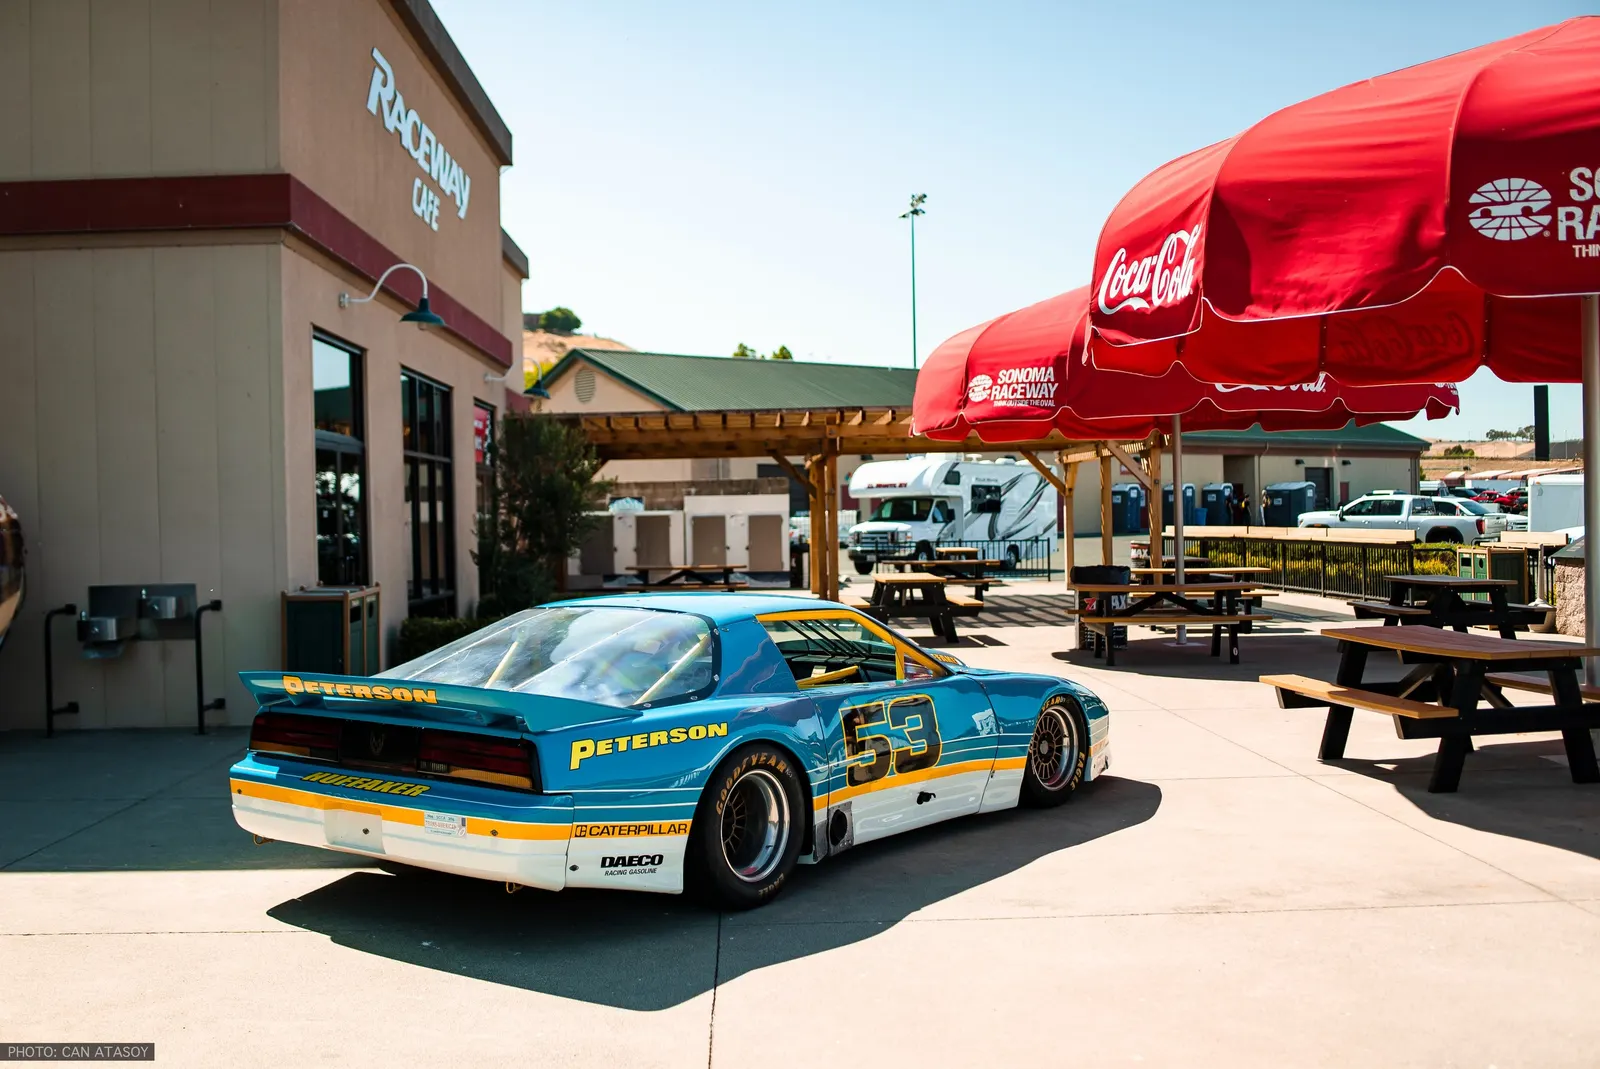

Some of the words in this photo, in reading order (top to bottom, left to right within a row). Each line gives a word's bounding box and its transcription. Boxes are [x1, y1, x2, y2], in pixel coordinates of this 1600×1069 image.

[367, 47, 471, 220] RACEWAY
[1569, 167, 1600, 201] S
[412, 177, 440, 232] CAFE
[1098, 223, 1202, 315] Coca-Cola
[997, 366, 1055, 384] SONOMA
[990, 383, 1059, 400] RACEWAY
[282, 674, 438, 704] PETERSON
[568, 722, 729, 771] PETERSON
[838, 694, 943, 788] 53
[300, 771, 431, 797] HUFFAKER
[589, 823, 688, 836] CATERPILLAR
[600, 854, 664, 868] DAECO
